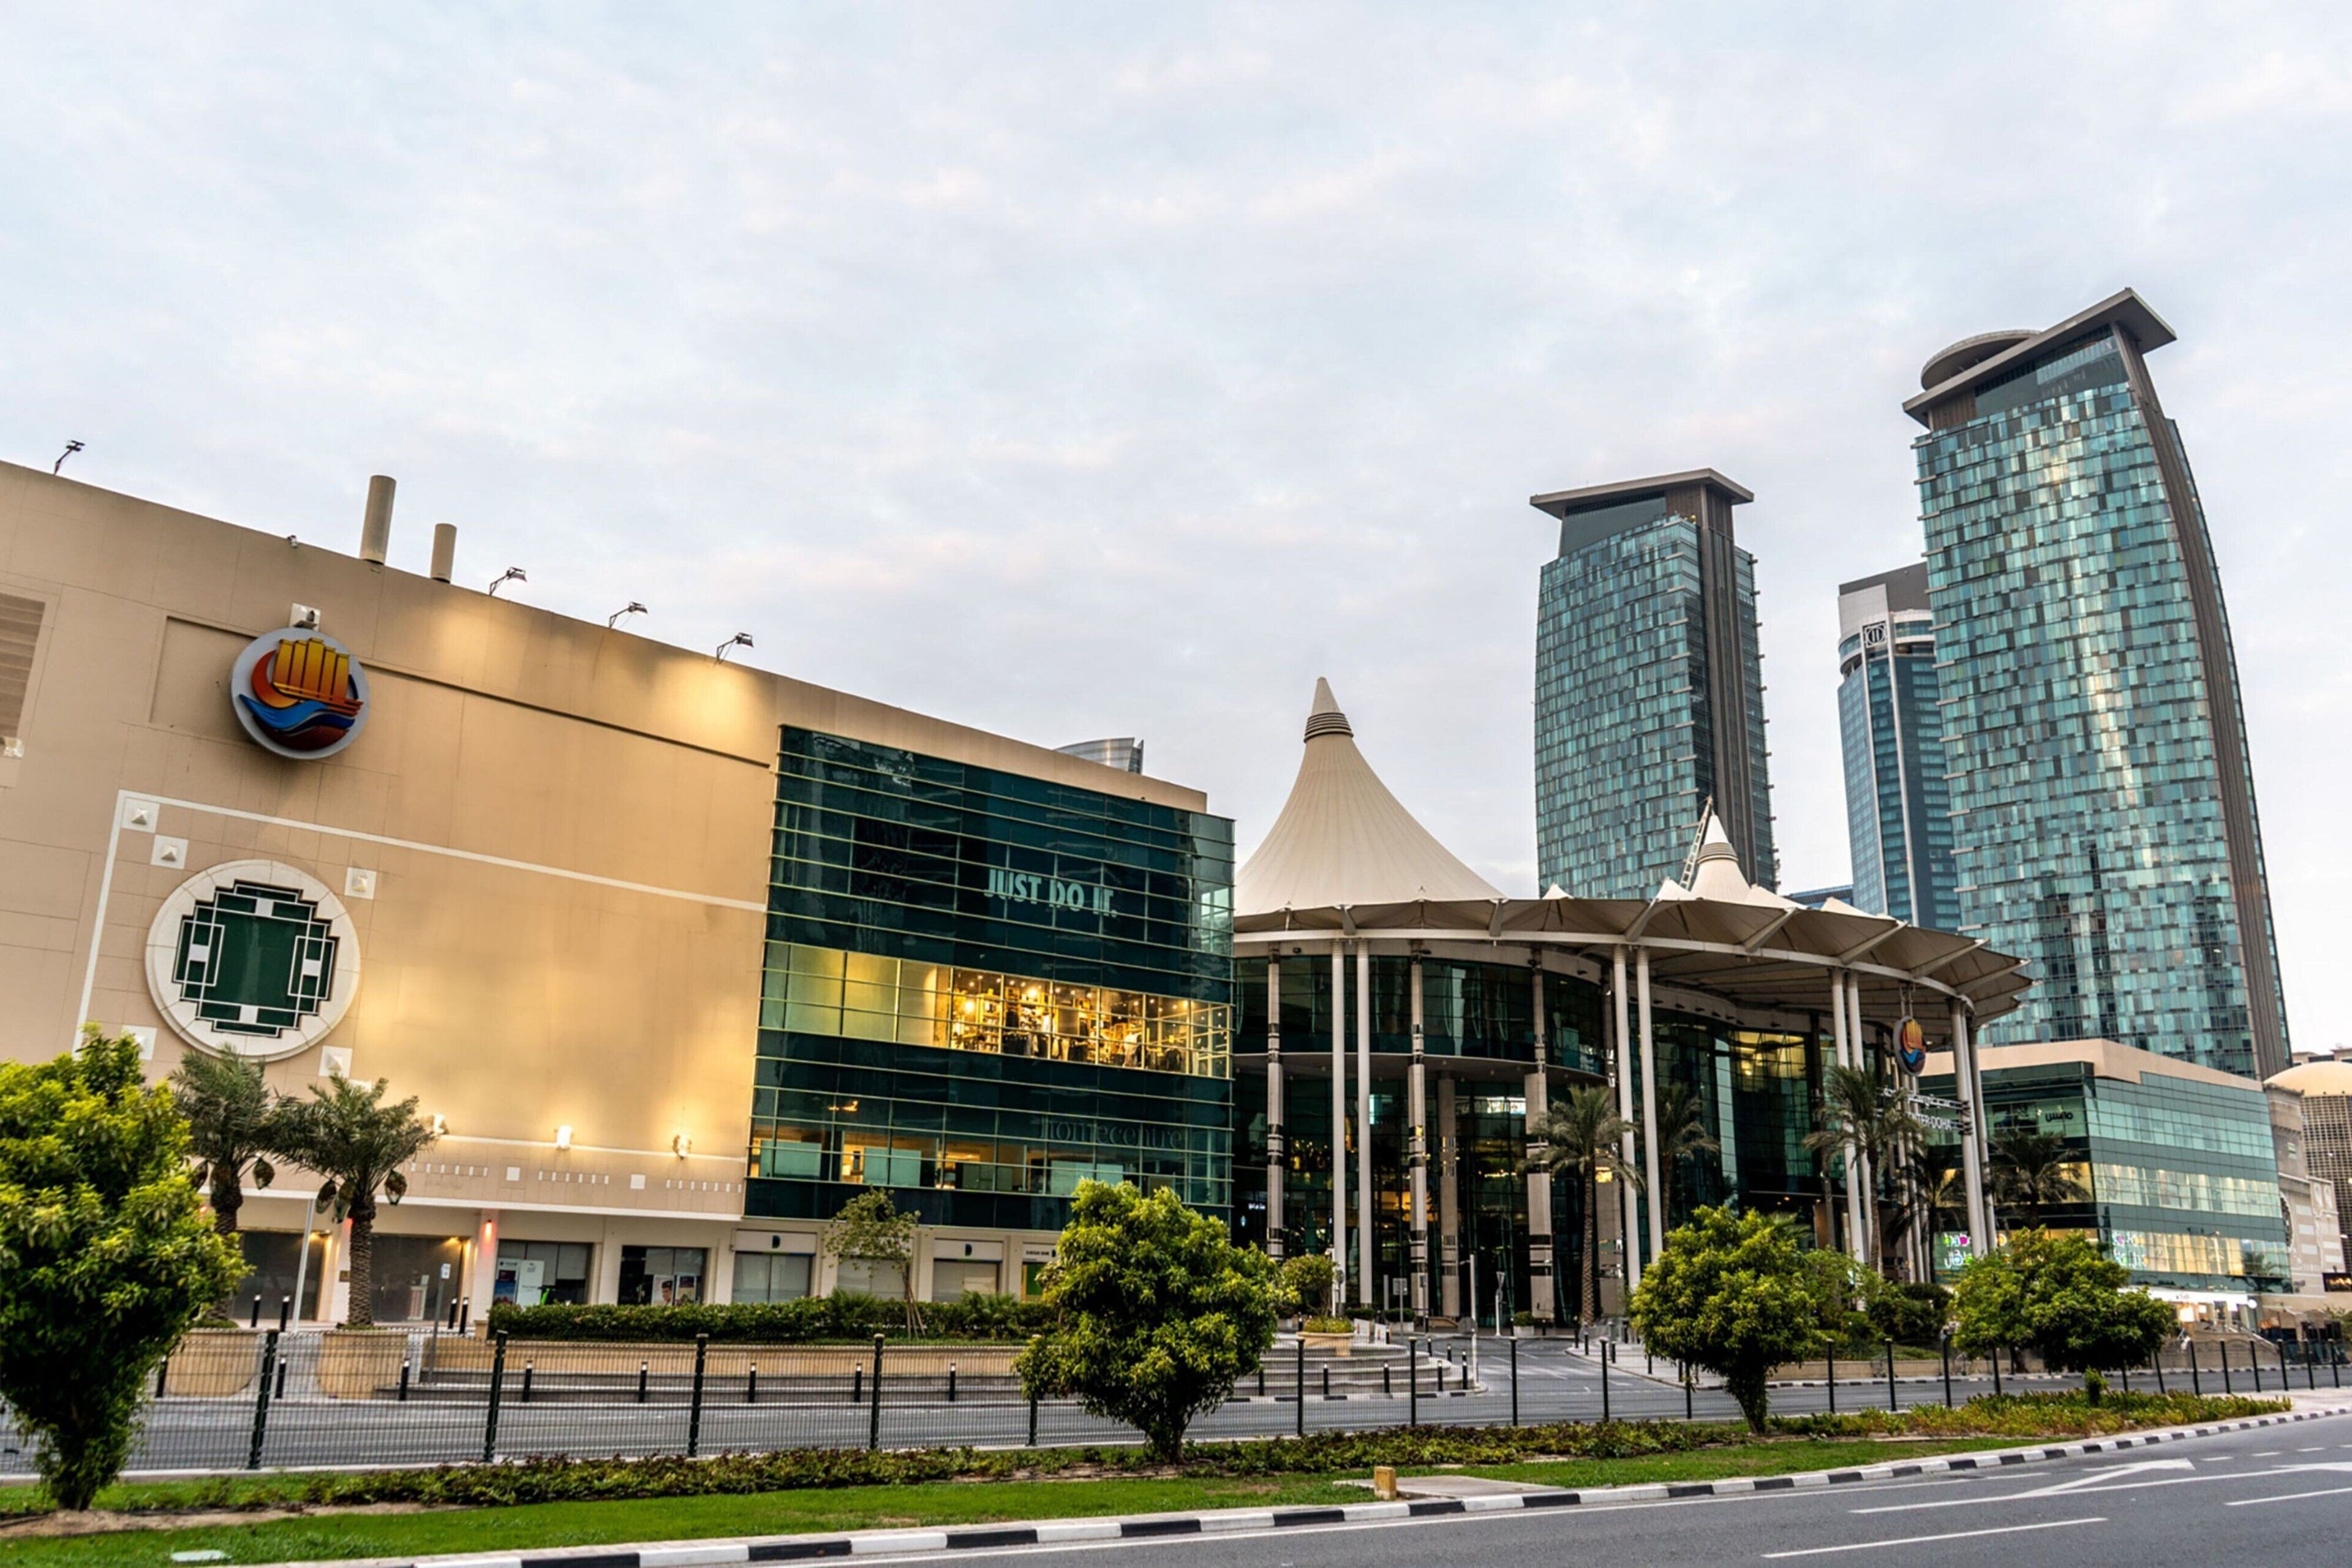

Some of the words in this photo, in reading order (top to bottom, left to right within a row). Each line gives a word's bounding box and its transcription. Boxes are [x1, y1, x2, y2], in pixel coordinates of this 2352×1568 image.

[984, 868, 1042, 904] JUST
[1049, 878, 1085, 911] DO
[1093, 886, 1118, 918] IT.
